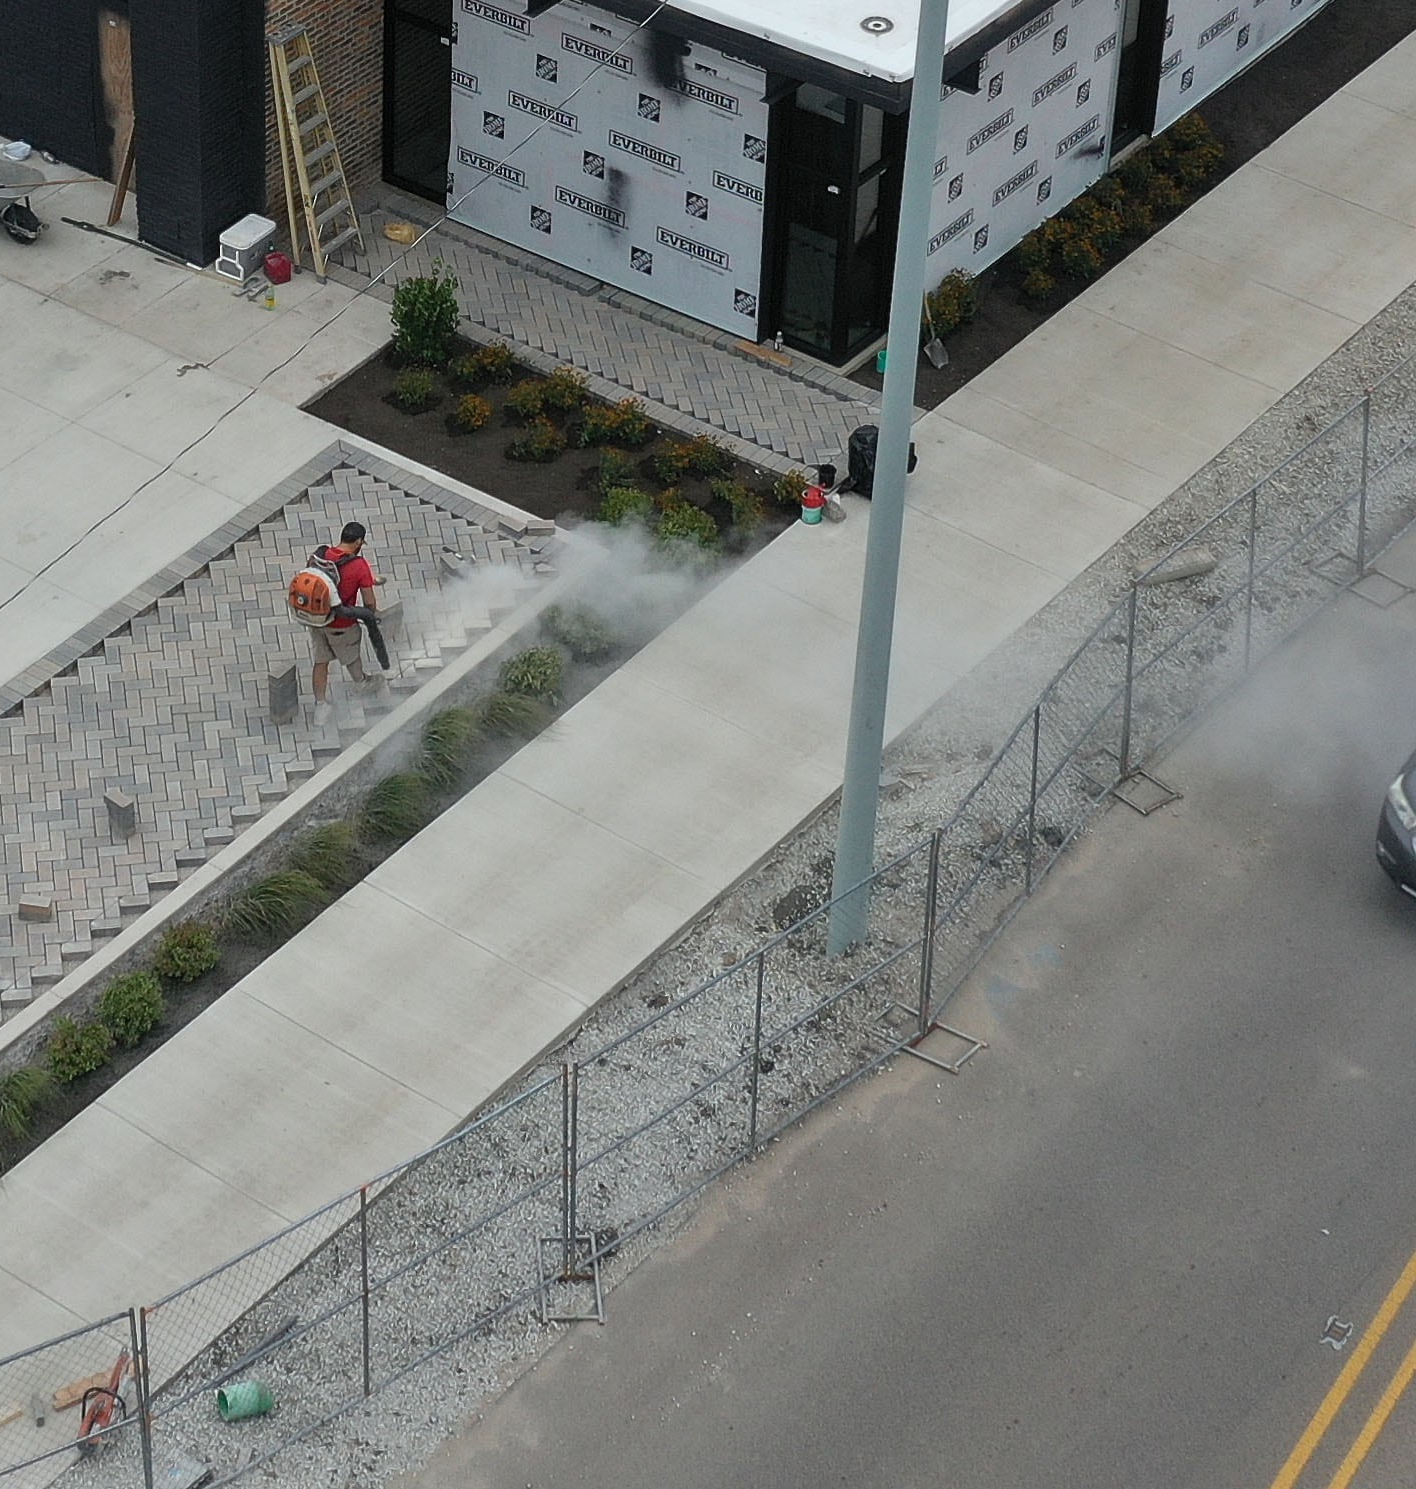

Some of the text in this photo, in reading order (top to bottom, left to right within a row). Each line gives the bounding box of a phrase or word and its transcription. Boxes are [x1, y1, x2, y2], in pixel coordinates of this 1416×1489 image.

[459, 150, 523, 184] EVERBILT
[612, 133, 678, 168] EVERBILT
[558, 189, 622, 224] EVERBILT
[660, 230, 725, 265] EVERBILT
